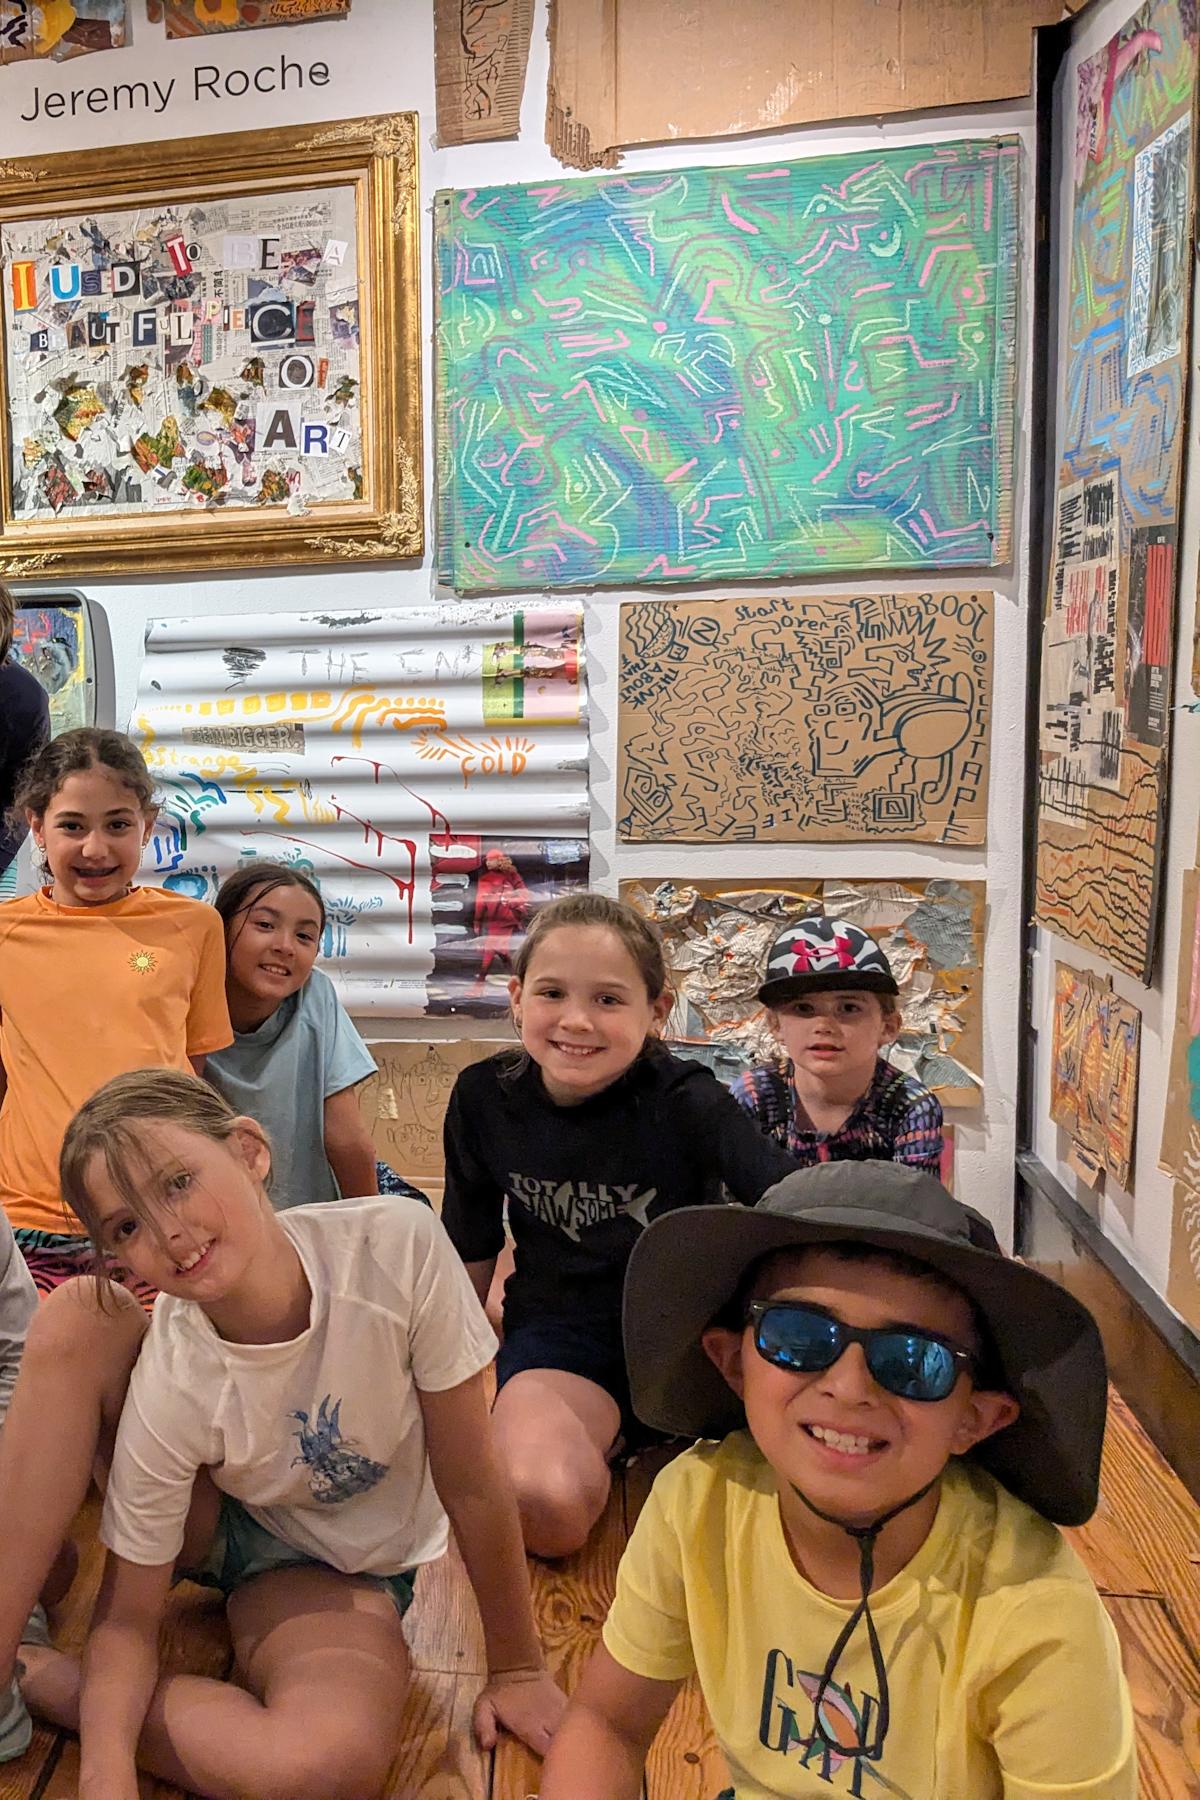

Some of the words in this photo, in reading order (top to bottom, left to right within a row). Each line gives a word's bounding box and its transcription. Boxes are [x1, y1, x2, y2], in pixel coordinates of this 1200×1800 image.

[20, 78, 176, 122] Jeremy
[193, 54, 331, 101] Roche
[51, 263, 136, 300] USED
[262, 409, 351, 454] ART
[288, 648, 370, 685] THE
[509, 1172, 638, 1203] TOTALLY
